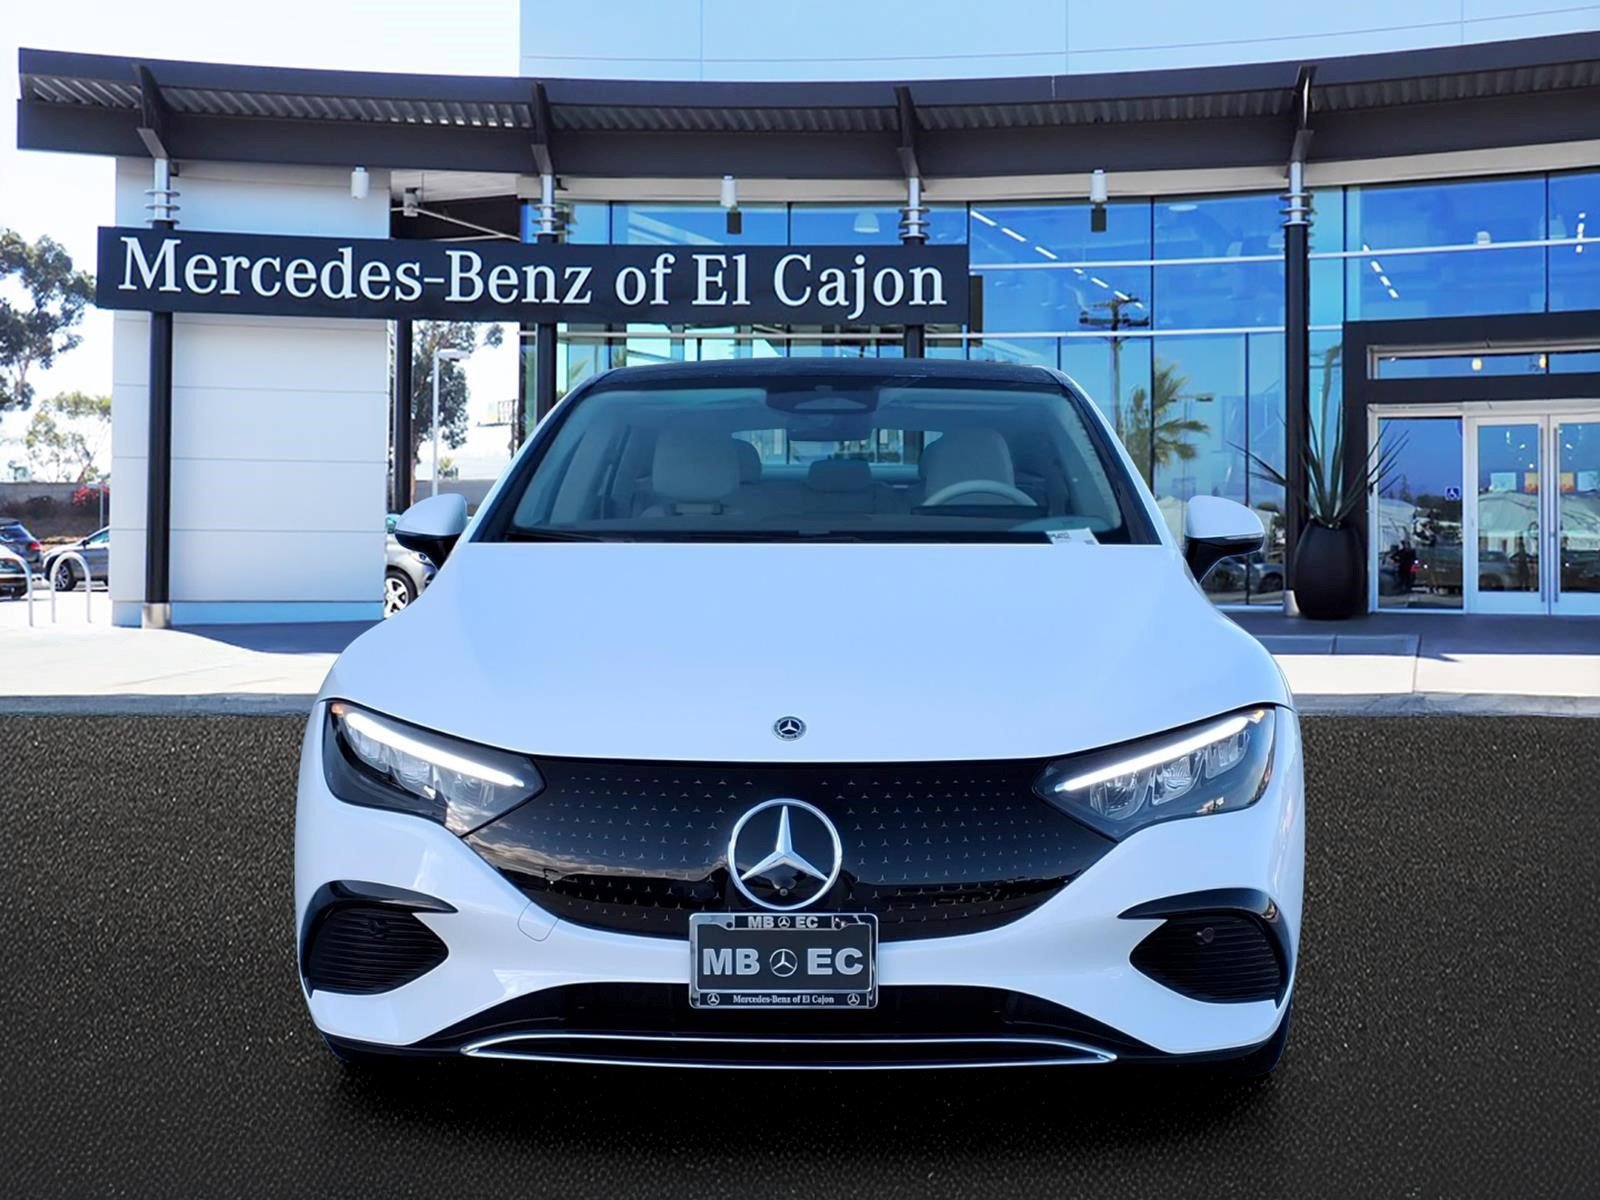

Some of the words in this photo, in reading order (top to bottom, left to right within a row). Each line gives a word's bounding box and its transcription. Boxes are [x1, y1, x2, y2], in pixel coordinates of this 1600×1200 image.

[118, 236, 593, 304] Mercedes-Benz
[615, 253, 676, 306] of
[691, 254, 751, 306] El
[773, 254, 947, 321] Cajon
[748, 916, 774, 928] MB
[795, 916, 818, 928] EC
[703, 948, 760, 975] MB
[807, 947, 863, 975] EC
[733, 995, 790, 1004] Mercedes-Benz
[792, 995, 801, 1003] of
[802, 995, 811, 1003] El
[812, 995, 834, 1005] Cajon
